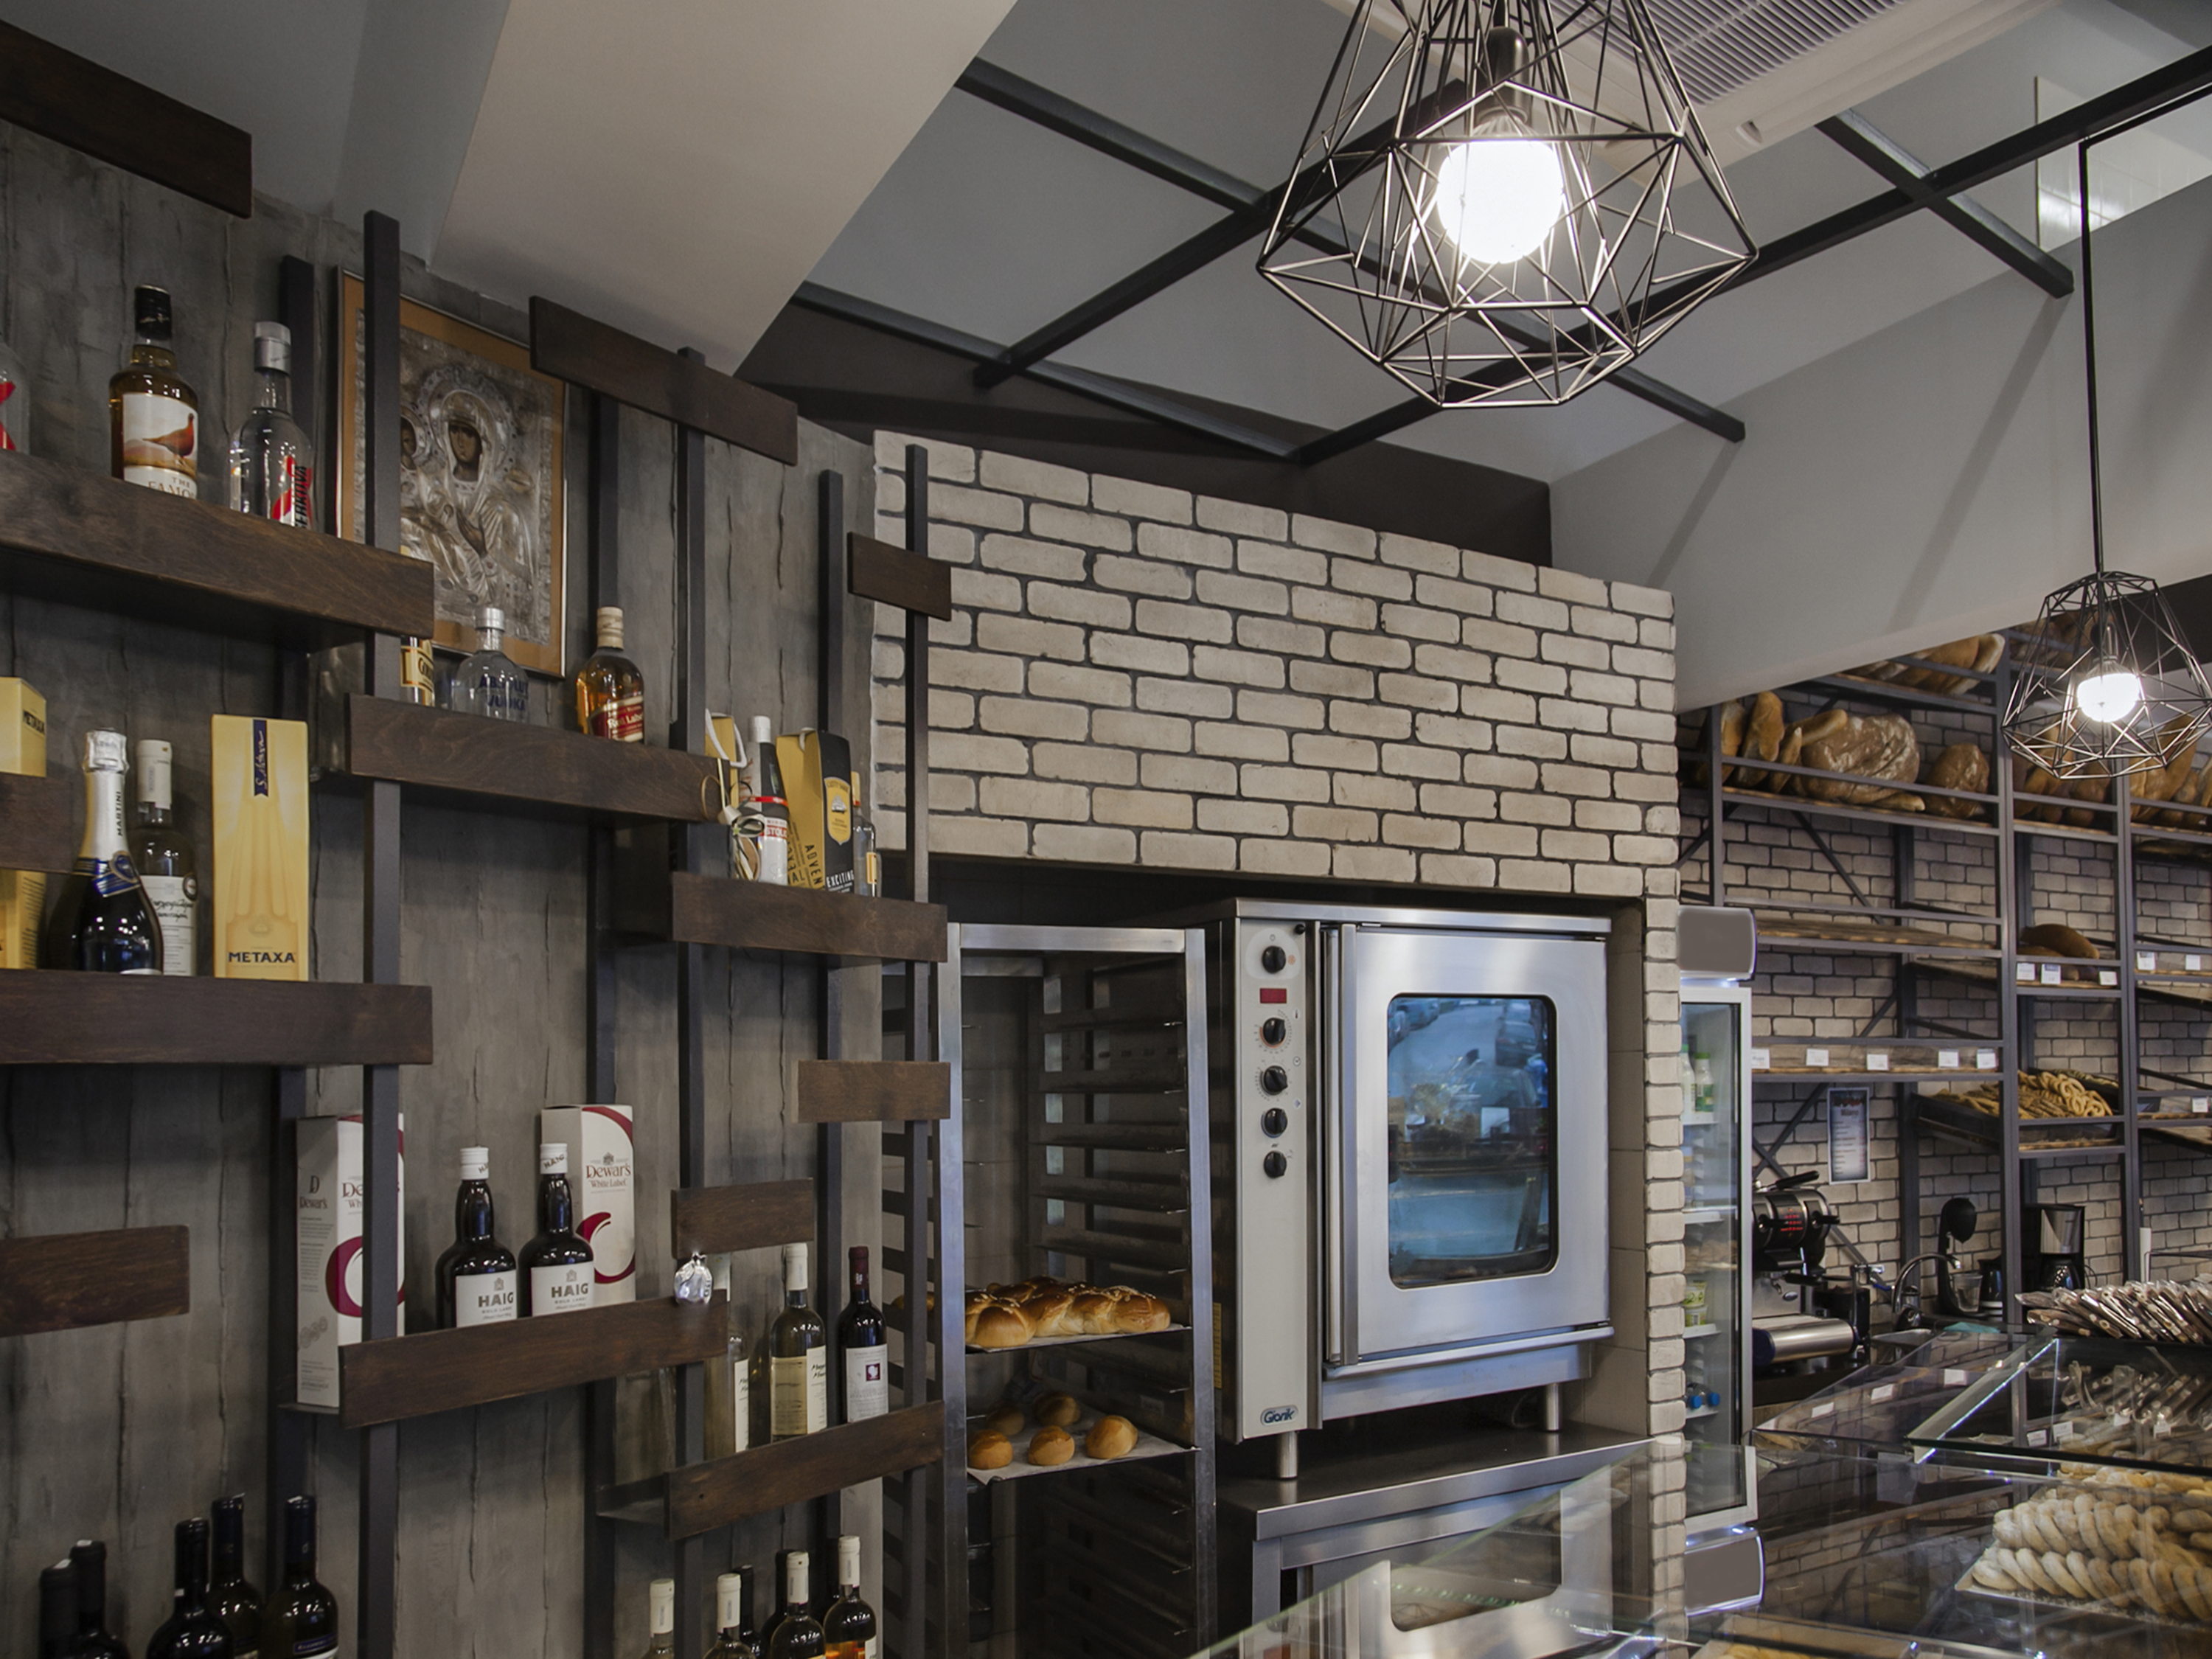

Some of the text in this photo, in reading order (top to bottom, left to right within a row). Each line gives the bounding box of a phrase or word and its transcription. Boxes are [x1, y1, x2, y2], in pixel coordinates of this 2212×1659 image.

[172, 477, 190, 488] THE
[115, 791, 123, 836] MARTINI
[804, 844, 825, 888] ADVEN
[826, 869, 854, 888] EXCITING
[228, 952, 296, 963] METAXA
[543, 1153, 565, 1169] HAIG
[586, 1163, 631, 1178] Dewar's
[590, 1180, 608, 1188] White
[551, 1283, 588, 1298] HAIG
[478, 1292, 514, 1307] HAIG
[1264, 1408, 1295, 1423] Giorik
